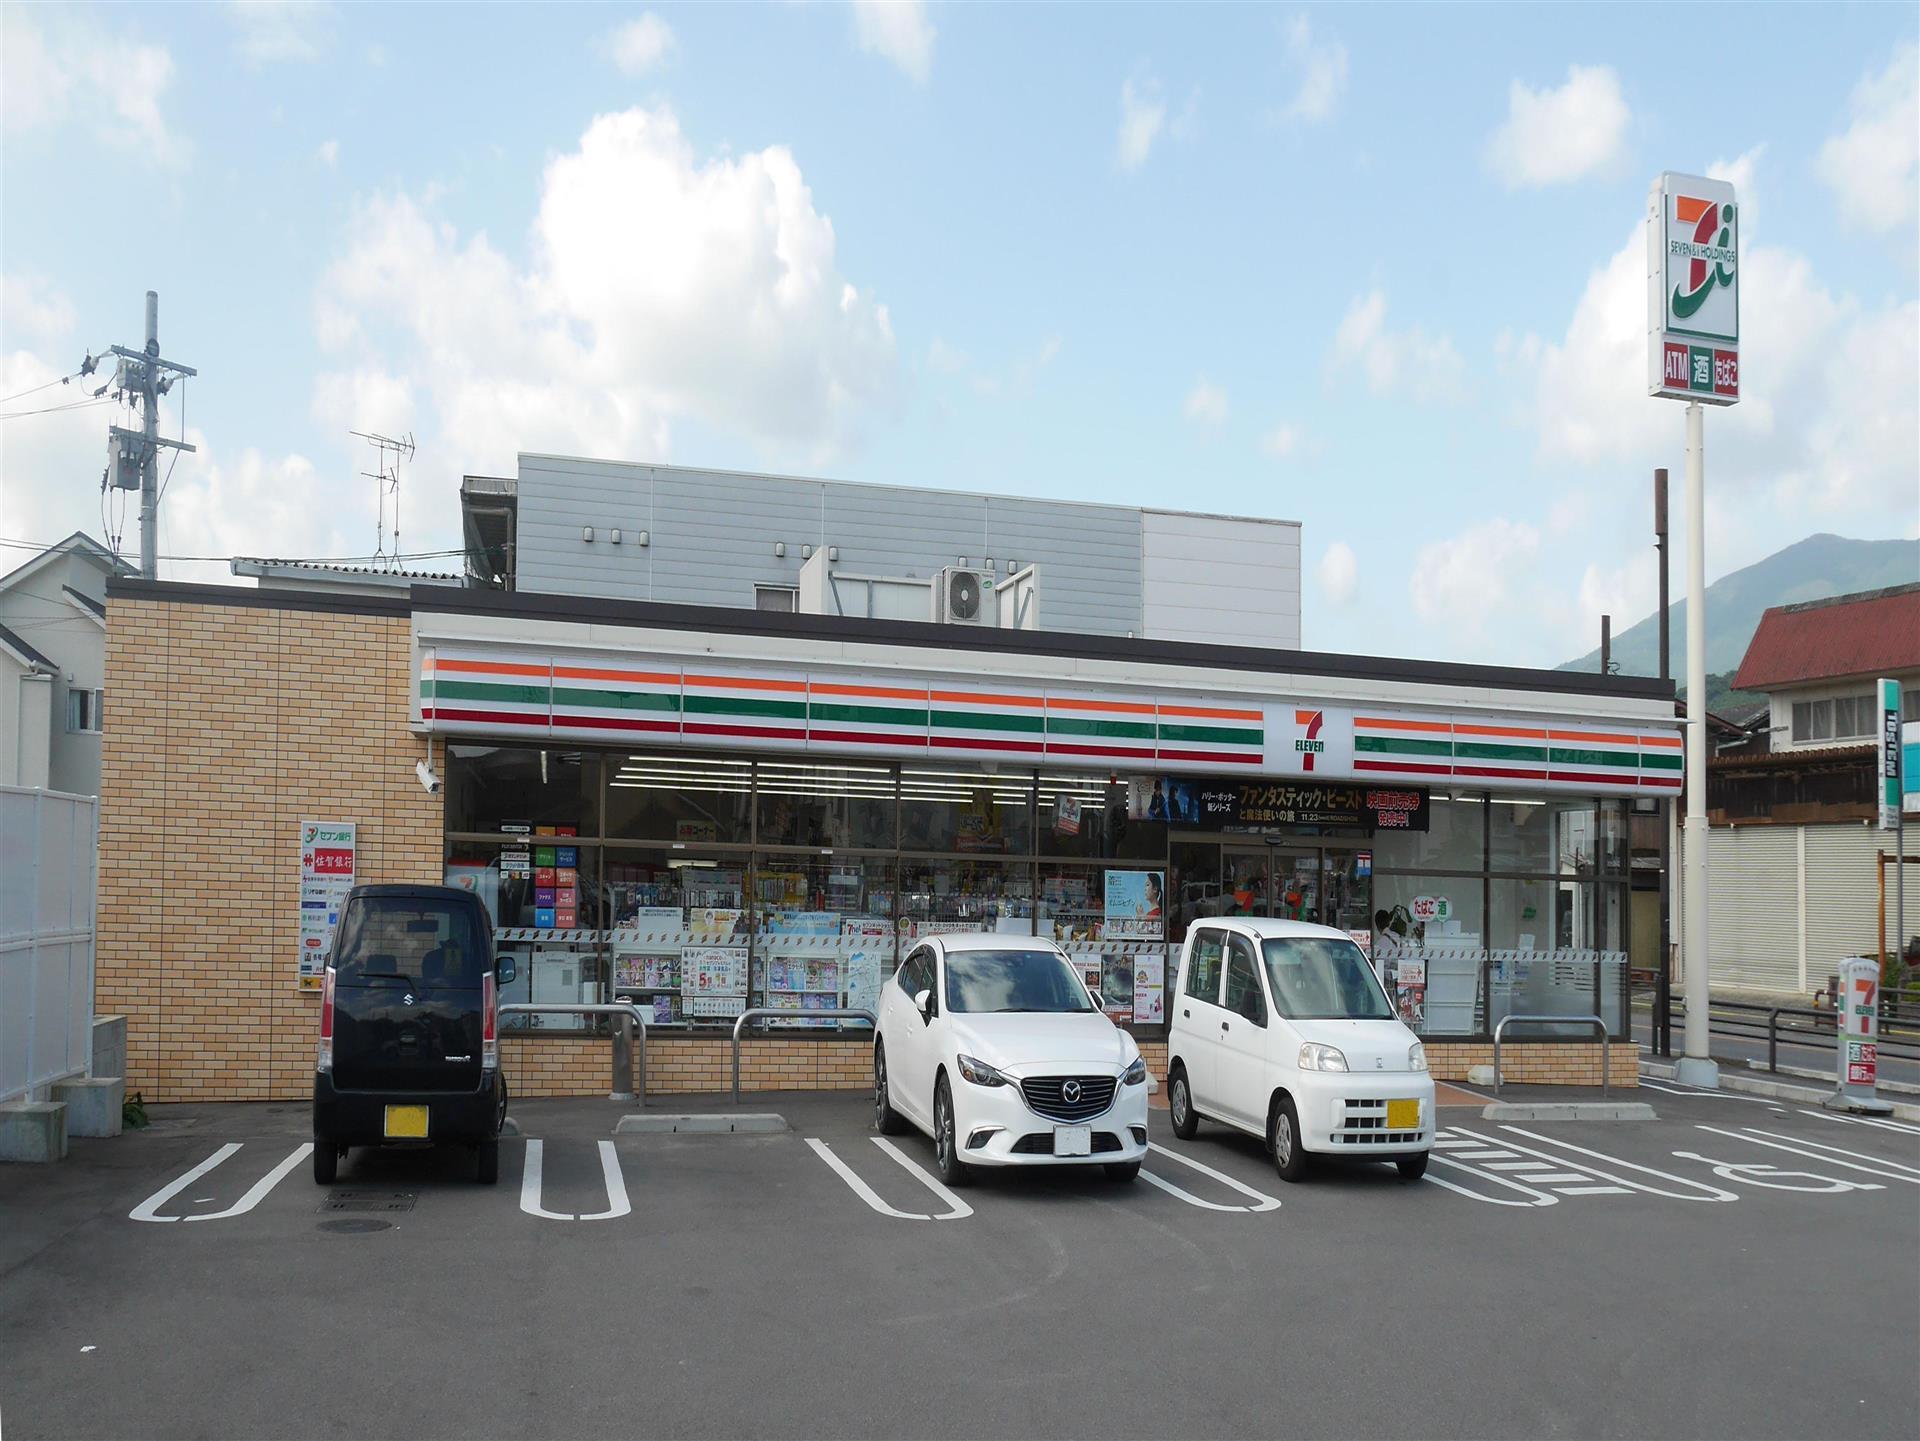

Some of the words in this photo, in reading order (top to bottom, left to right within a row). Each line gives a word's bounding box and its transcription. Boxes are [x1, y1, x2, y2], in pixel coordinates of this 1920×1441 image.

[1701, 245, 1735, 263] HOLDINGS
[1665, 350, 1687, 381] ATM
[1693, 355, 1709, 384] 酒
[1714, 357, 1738, 387] たばこ
[1886, 712, 1898, 777] TOSTEM
[1201, 791, 1237, 802] ハリー・ポッター
[1240, 785, 1362, 810] ファンタスティック・ビースト
[1366, 791, 1420, 811] 映画前売券
[1207, 802, 1232, 812] 新シリーズ
[1239, 809, 1295, 822] と魔法使いの旅
[319, 830, 351, 842] セブン銀行
[315, 855, 352, 869] 佐賀銀行
[1414, 899, 1435, 915] たばこ
[1438, 900, 1447, 915] 酒
